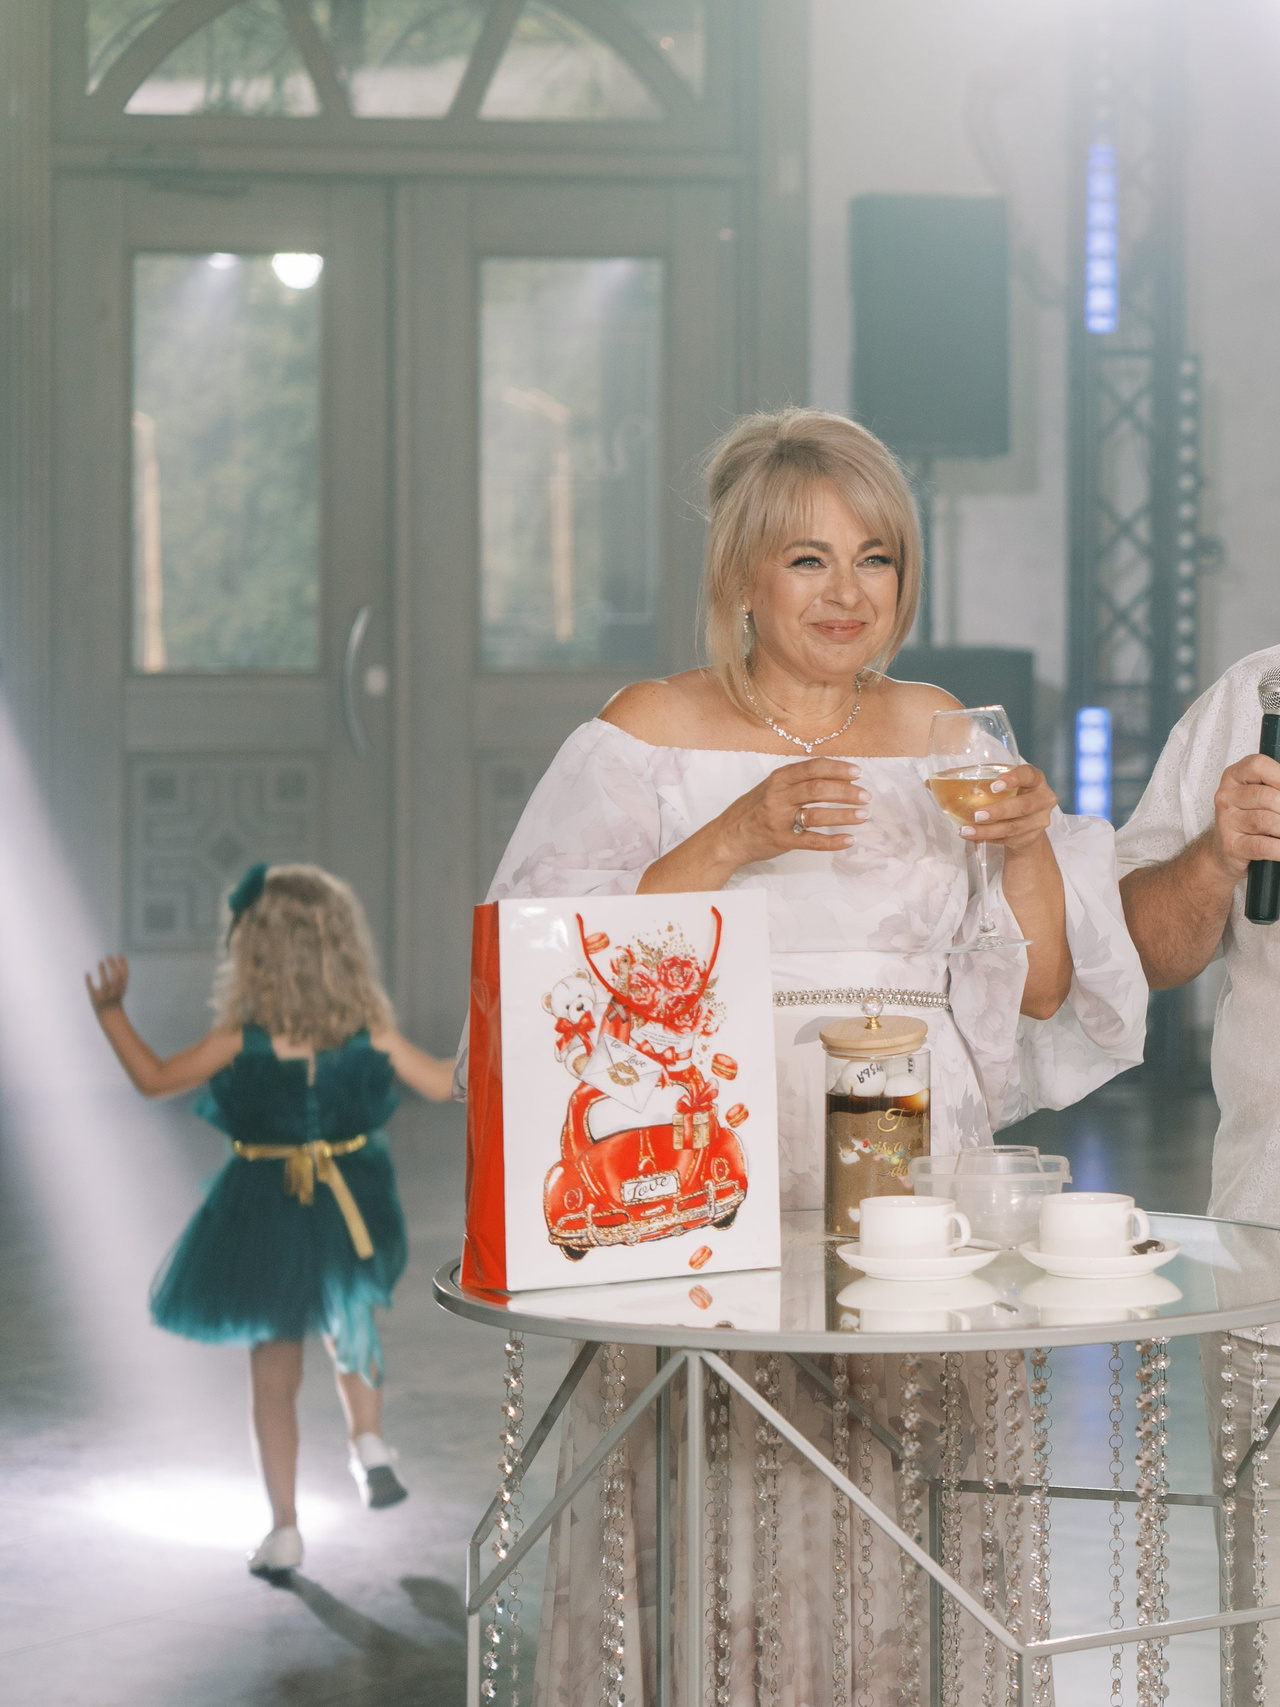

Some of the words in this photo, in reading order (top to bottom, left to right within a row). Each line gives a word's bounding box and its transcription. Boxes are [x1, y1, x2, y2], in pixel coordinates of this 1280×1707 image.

[624, 1054, 647, 1068] Love
[890, 1158, 909, 1178] da
[627, 1177, 671, 1202] Love
